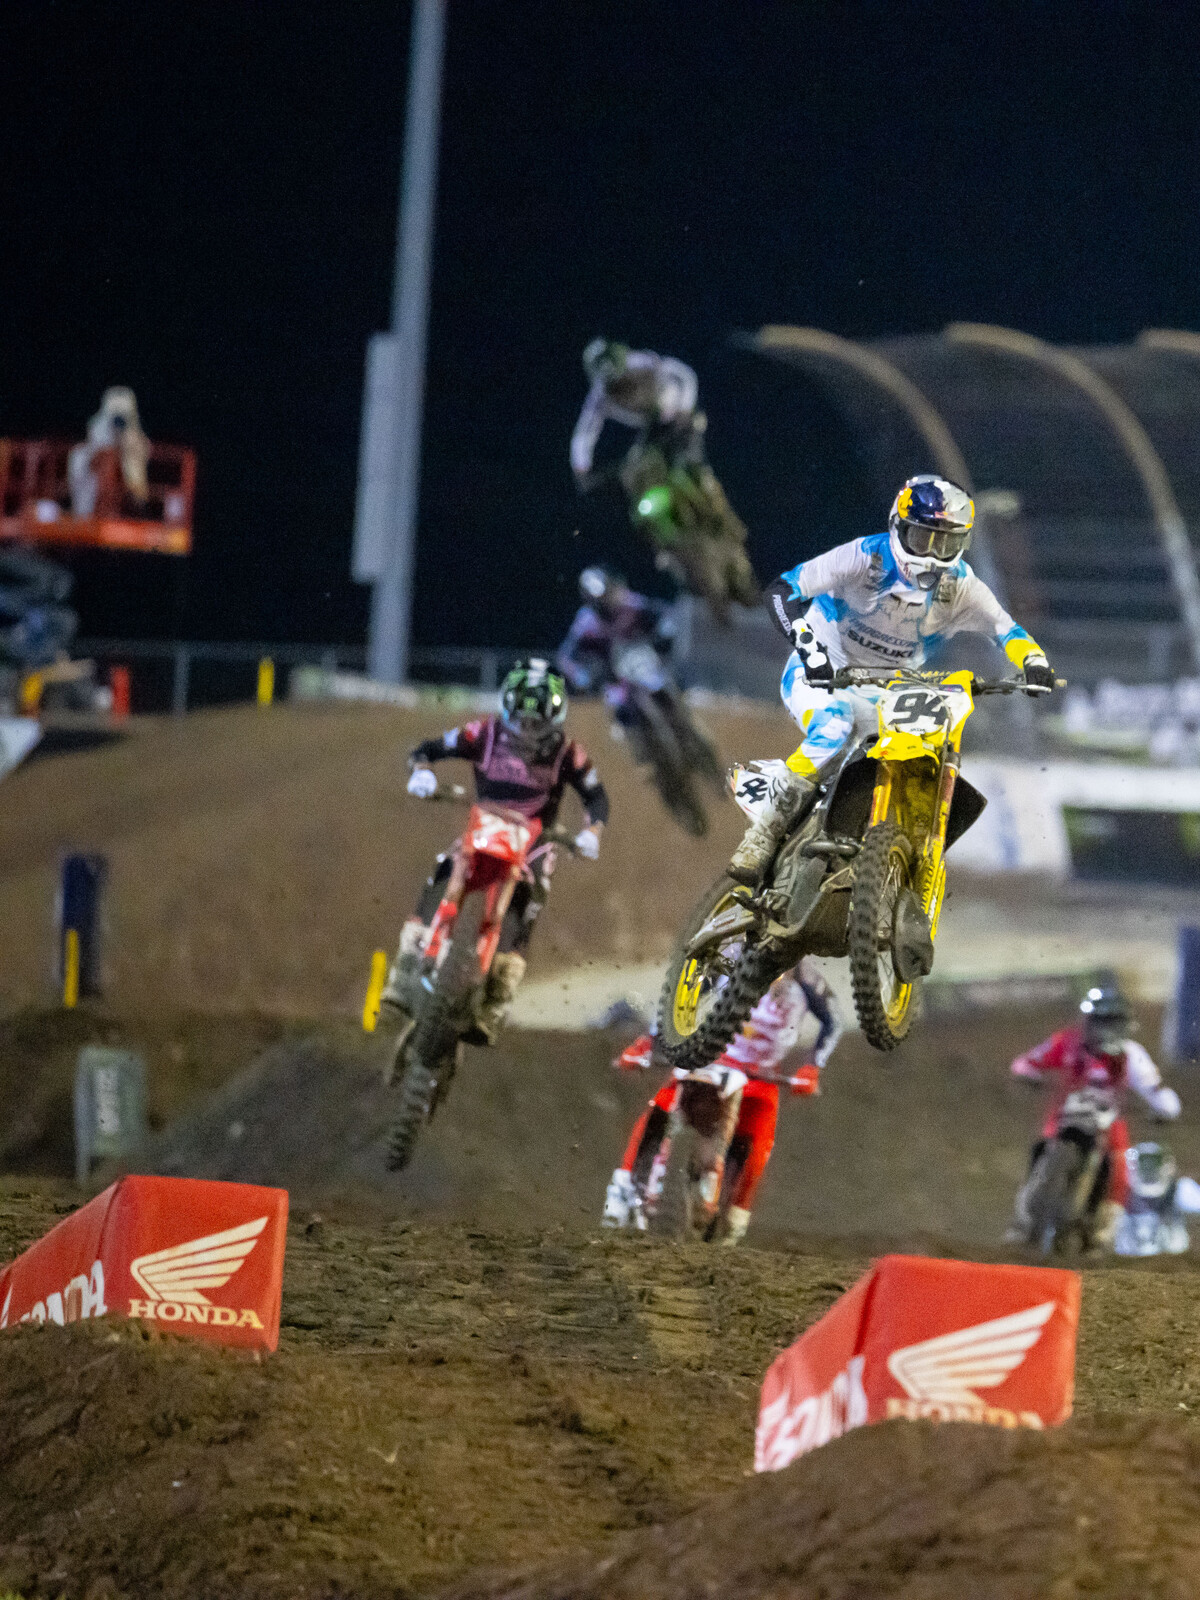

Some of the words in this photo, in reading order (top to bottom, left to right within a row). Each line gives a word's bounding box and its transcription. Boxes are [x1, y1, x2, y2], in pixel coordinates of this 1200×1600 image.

[848, 630, 914, 659] SUZUKI
[888, 692, 949, 726] 94
[20, 1259, 108, 1327] ONDA
[128, 1298, 264, 1330] HONDA
